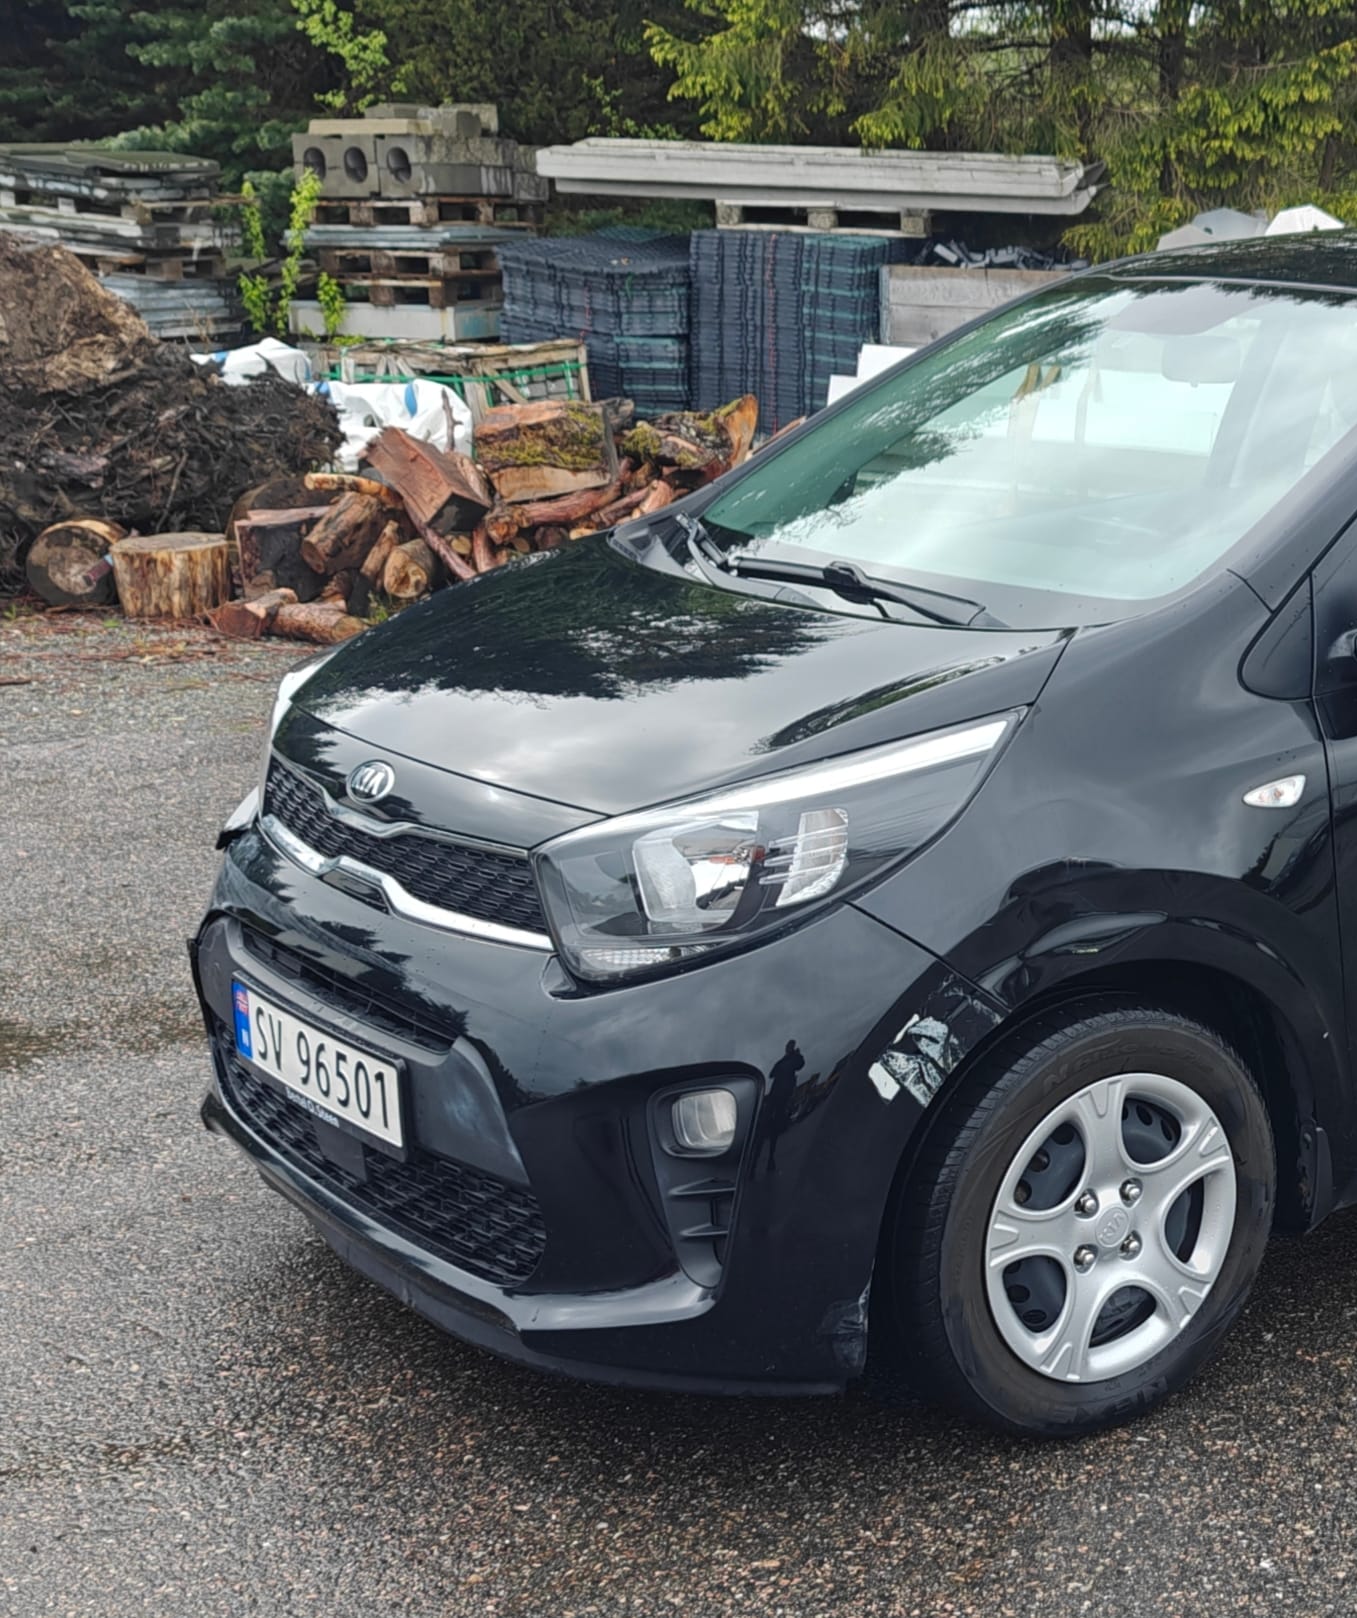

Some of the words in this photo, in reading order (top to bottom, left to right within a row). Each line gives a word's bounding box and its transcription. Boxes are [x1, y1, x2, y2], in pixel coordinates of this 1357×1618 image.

[352, 765, 385, 795] KIA
[255, 1006, 282, 1071] SV
[297, 1030, 388, 1129] 96501
